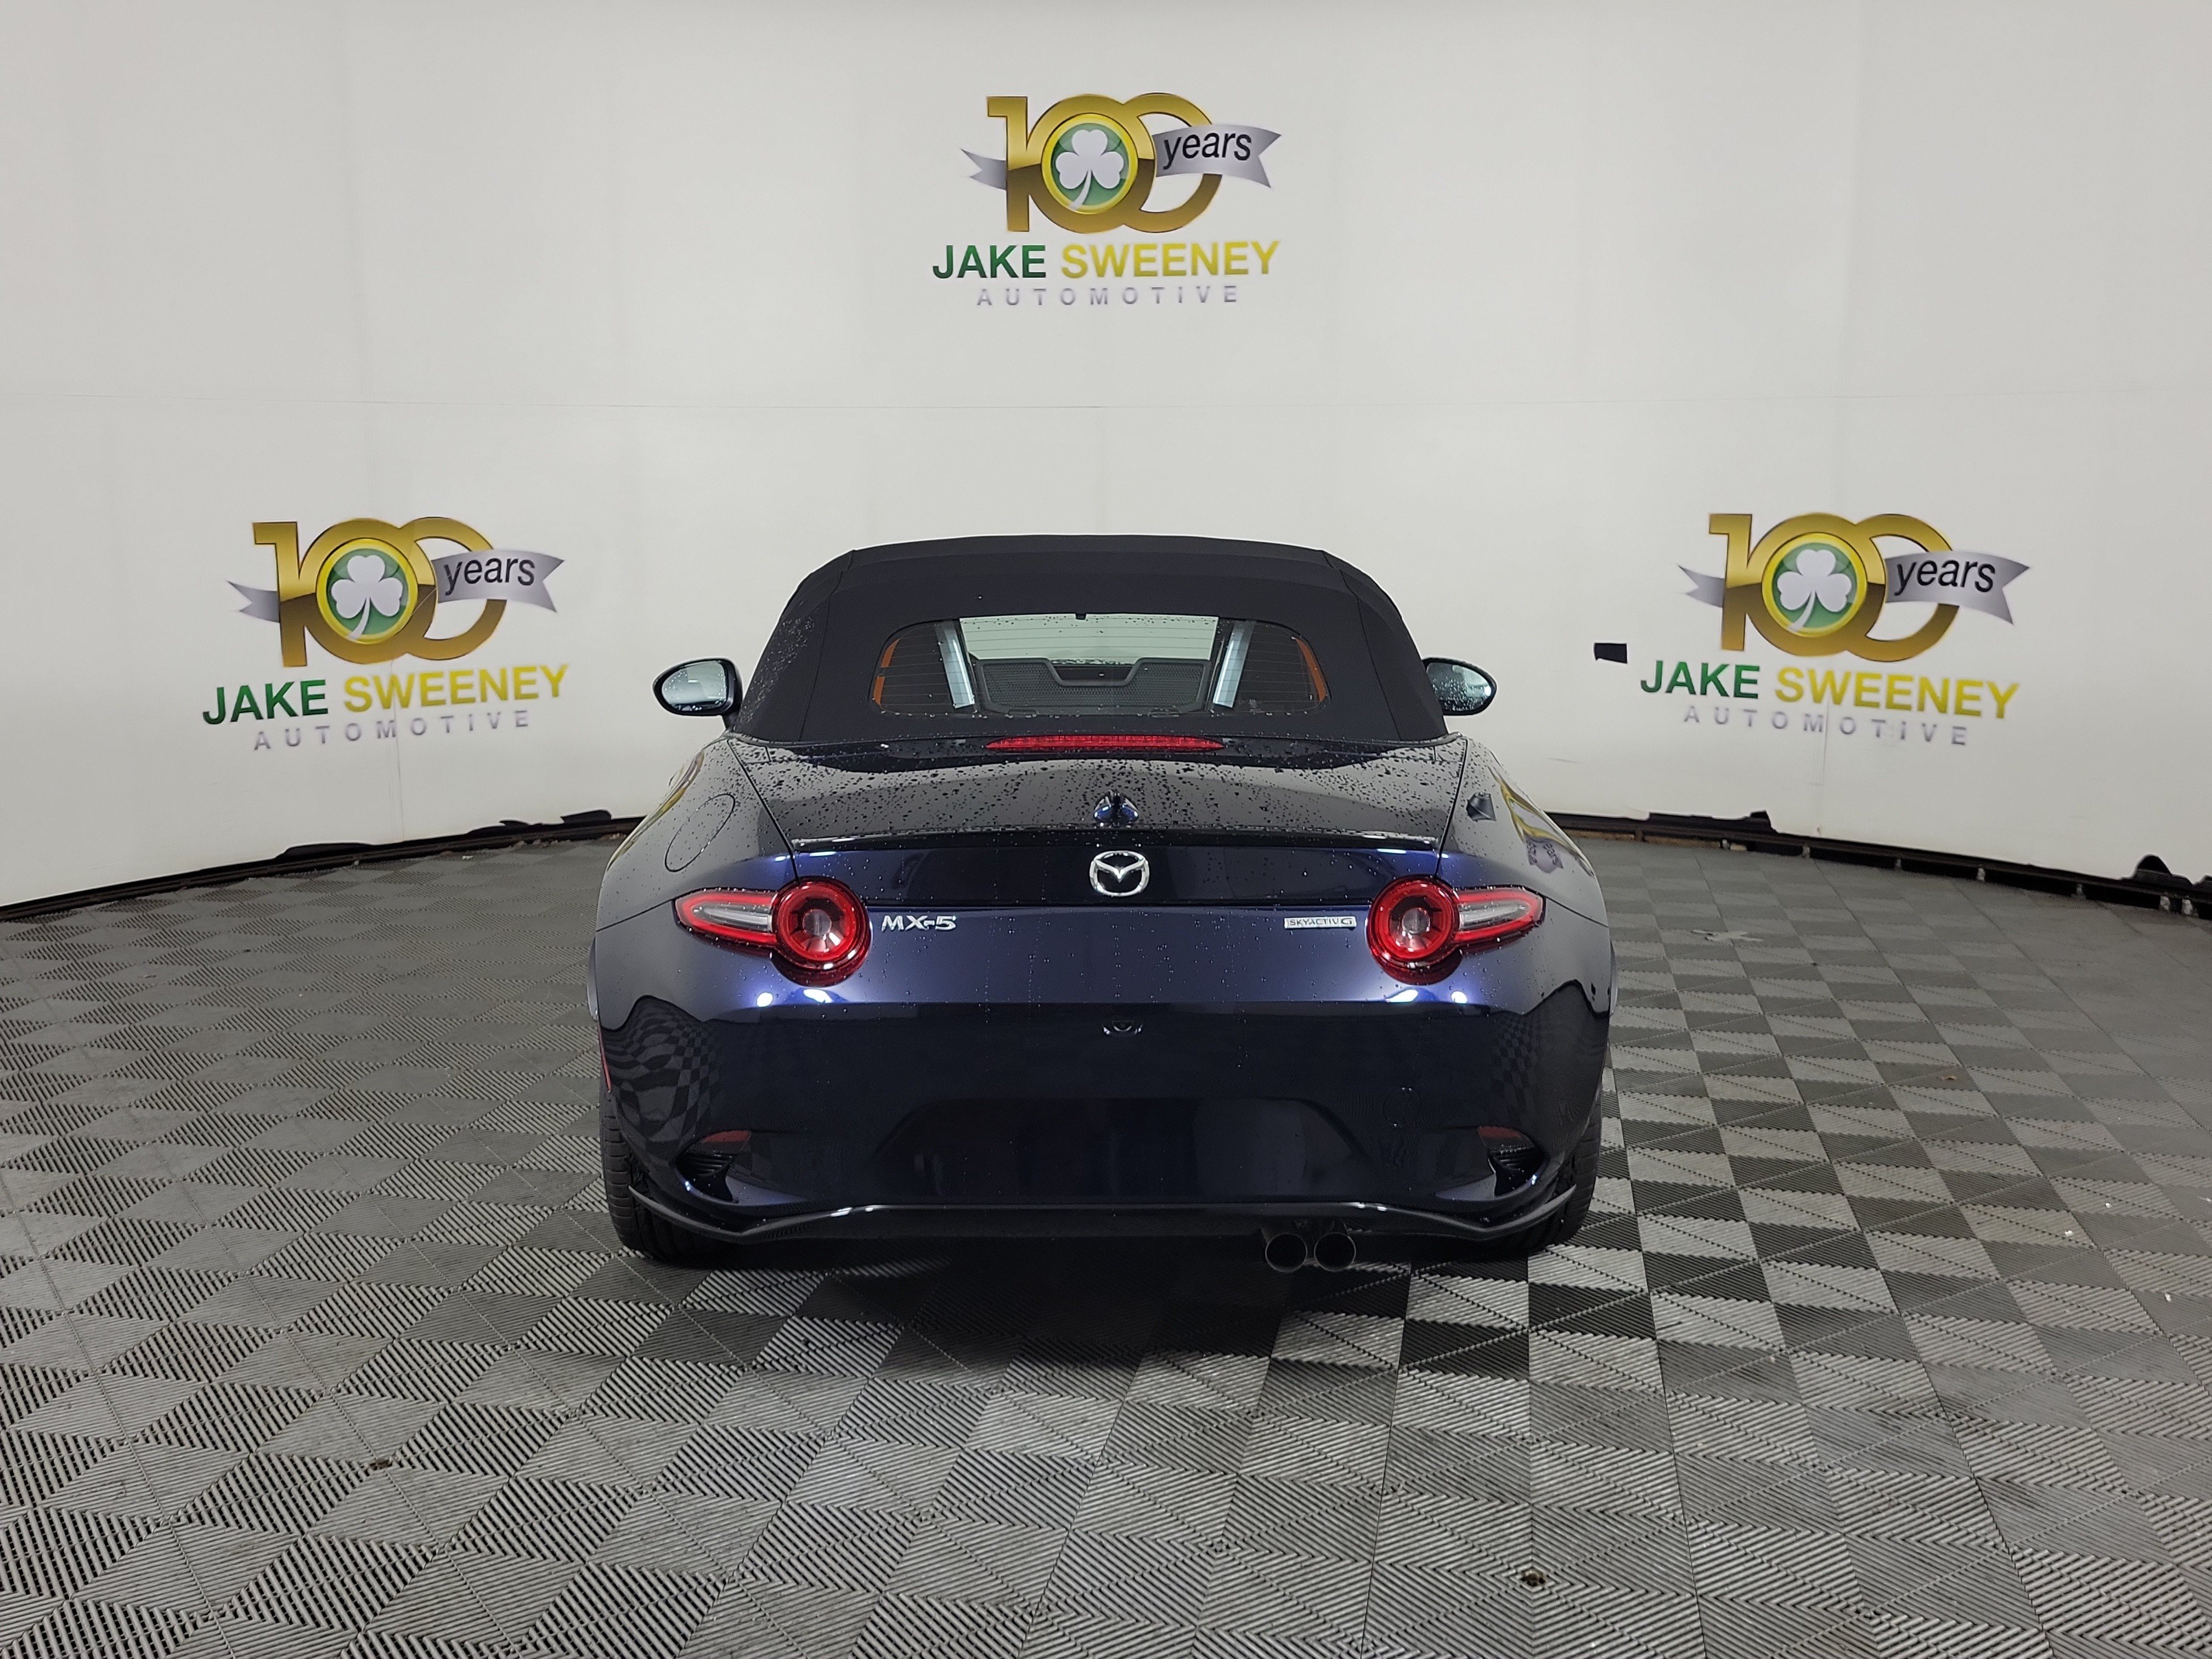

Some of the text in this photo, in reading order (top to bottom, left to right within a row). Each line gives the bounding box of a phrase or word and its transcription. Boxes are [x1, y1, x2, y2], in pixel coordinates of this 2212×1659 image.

[986, 92, 1252, 233] 100 years
[933, 240, 1280, 279] JAKE SWEENEY
[977, 285, 1238, 307] AUTOMOTIVE
[252, 516, 536, 667] 100 years
[1708, 512, 1996, 662] 100 years
[202, 664, 568, 725] JAKE SWEENEY
[1640, 660, 2019, 719] JAKE SWEENEY
[253, 709, 529, 751] AUTOMOTIVE
[1684, 706, 1967, 746] AUTOMOTIVE
[881, 915, 956, 932] MX-5
